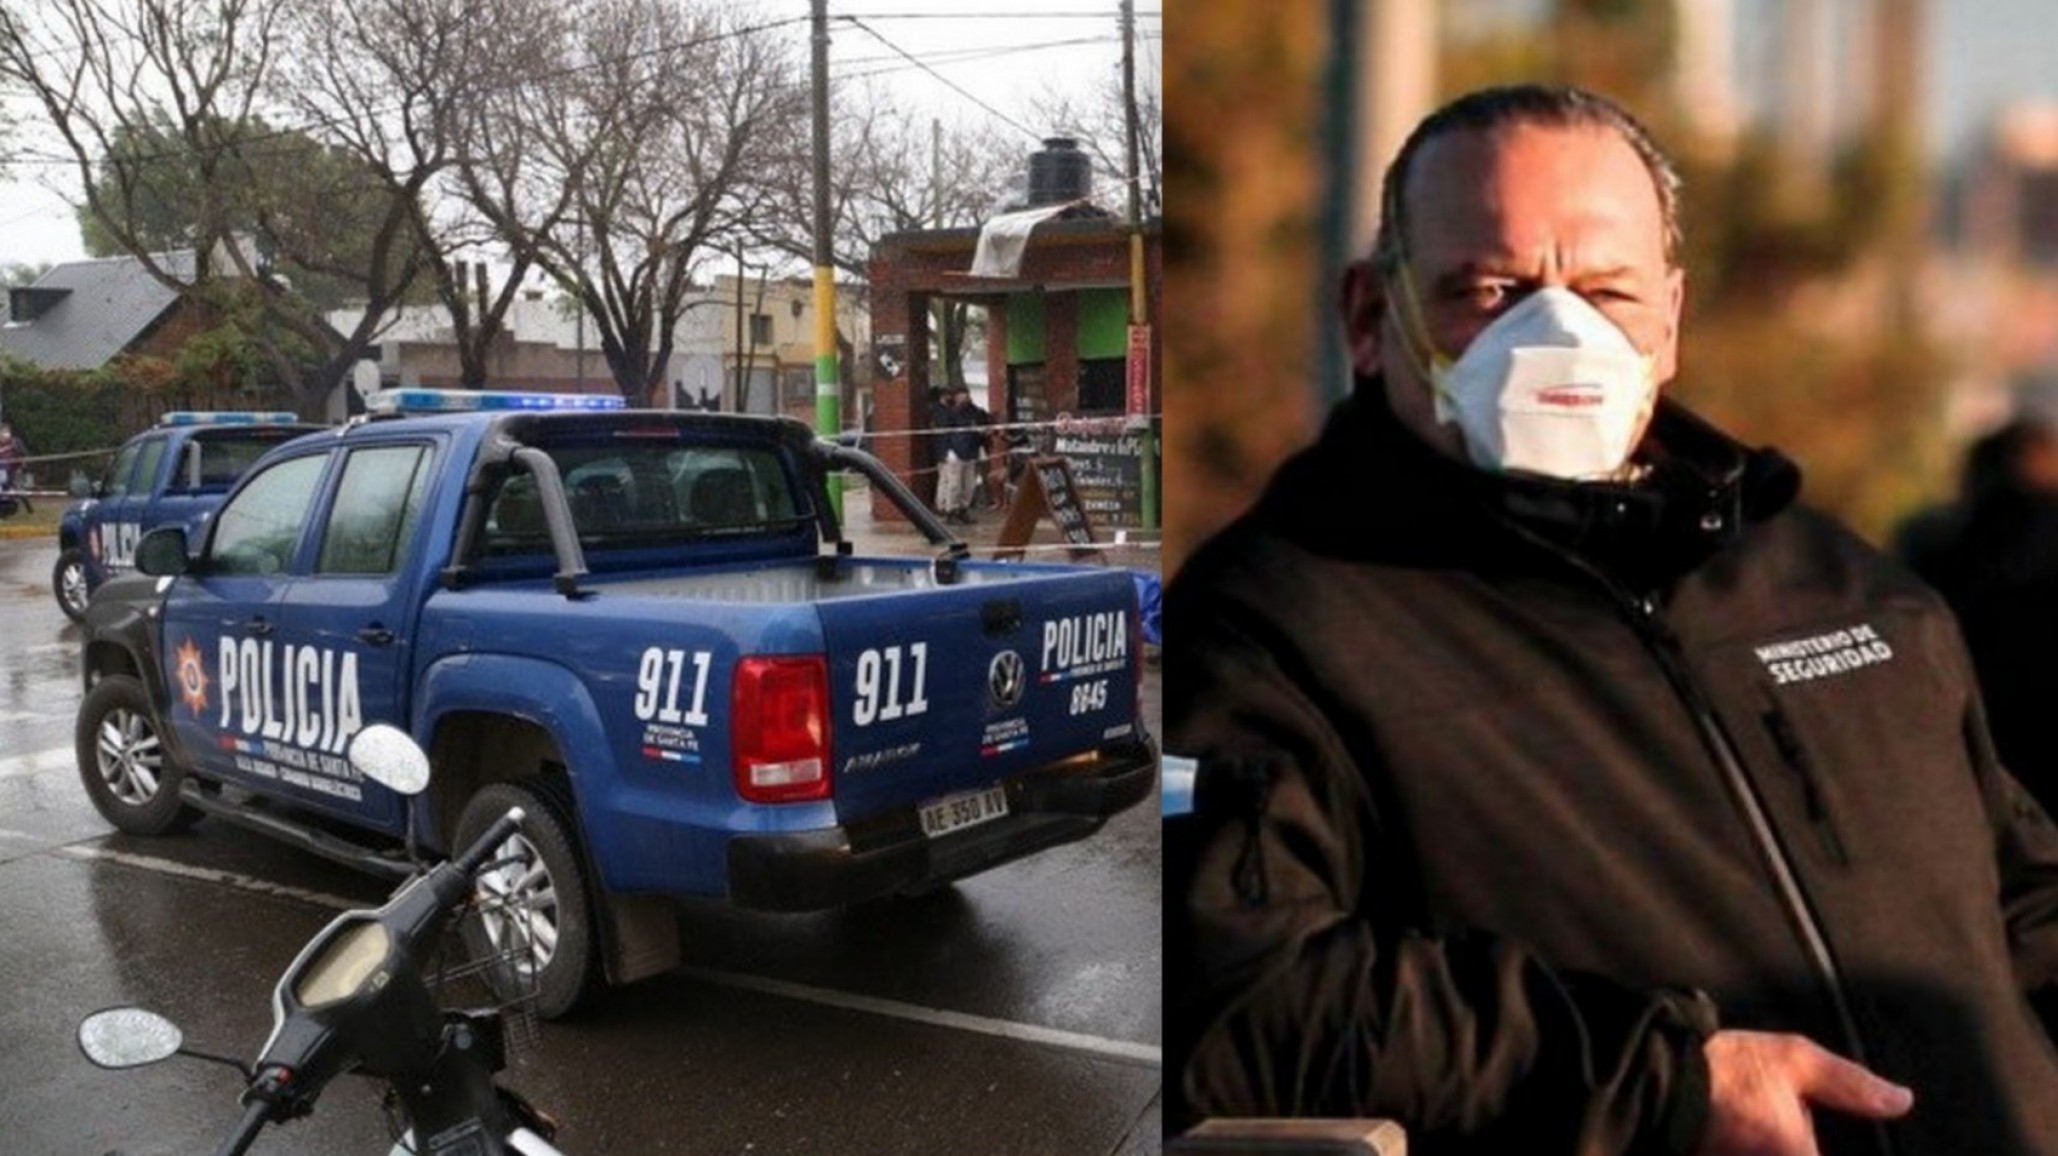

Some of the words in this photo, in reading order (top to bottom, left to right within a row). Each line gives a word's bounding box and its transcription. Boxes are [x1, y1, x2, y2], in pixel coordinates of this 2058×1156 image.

[1041, 610, 1127, 671] POLICIA
[1754, 630, 1852, 662] MINISTERIO
[1849, 623, 1878, 643] DE
[1768, 641, 1893, 684] SEGURIDAD
[219, 635, 362, 754] POLICIA
[635, 646, 711, 725] 911
[852, 641, 929, 727] 911
